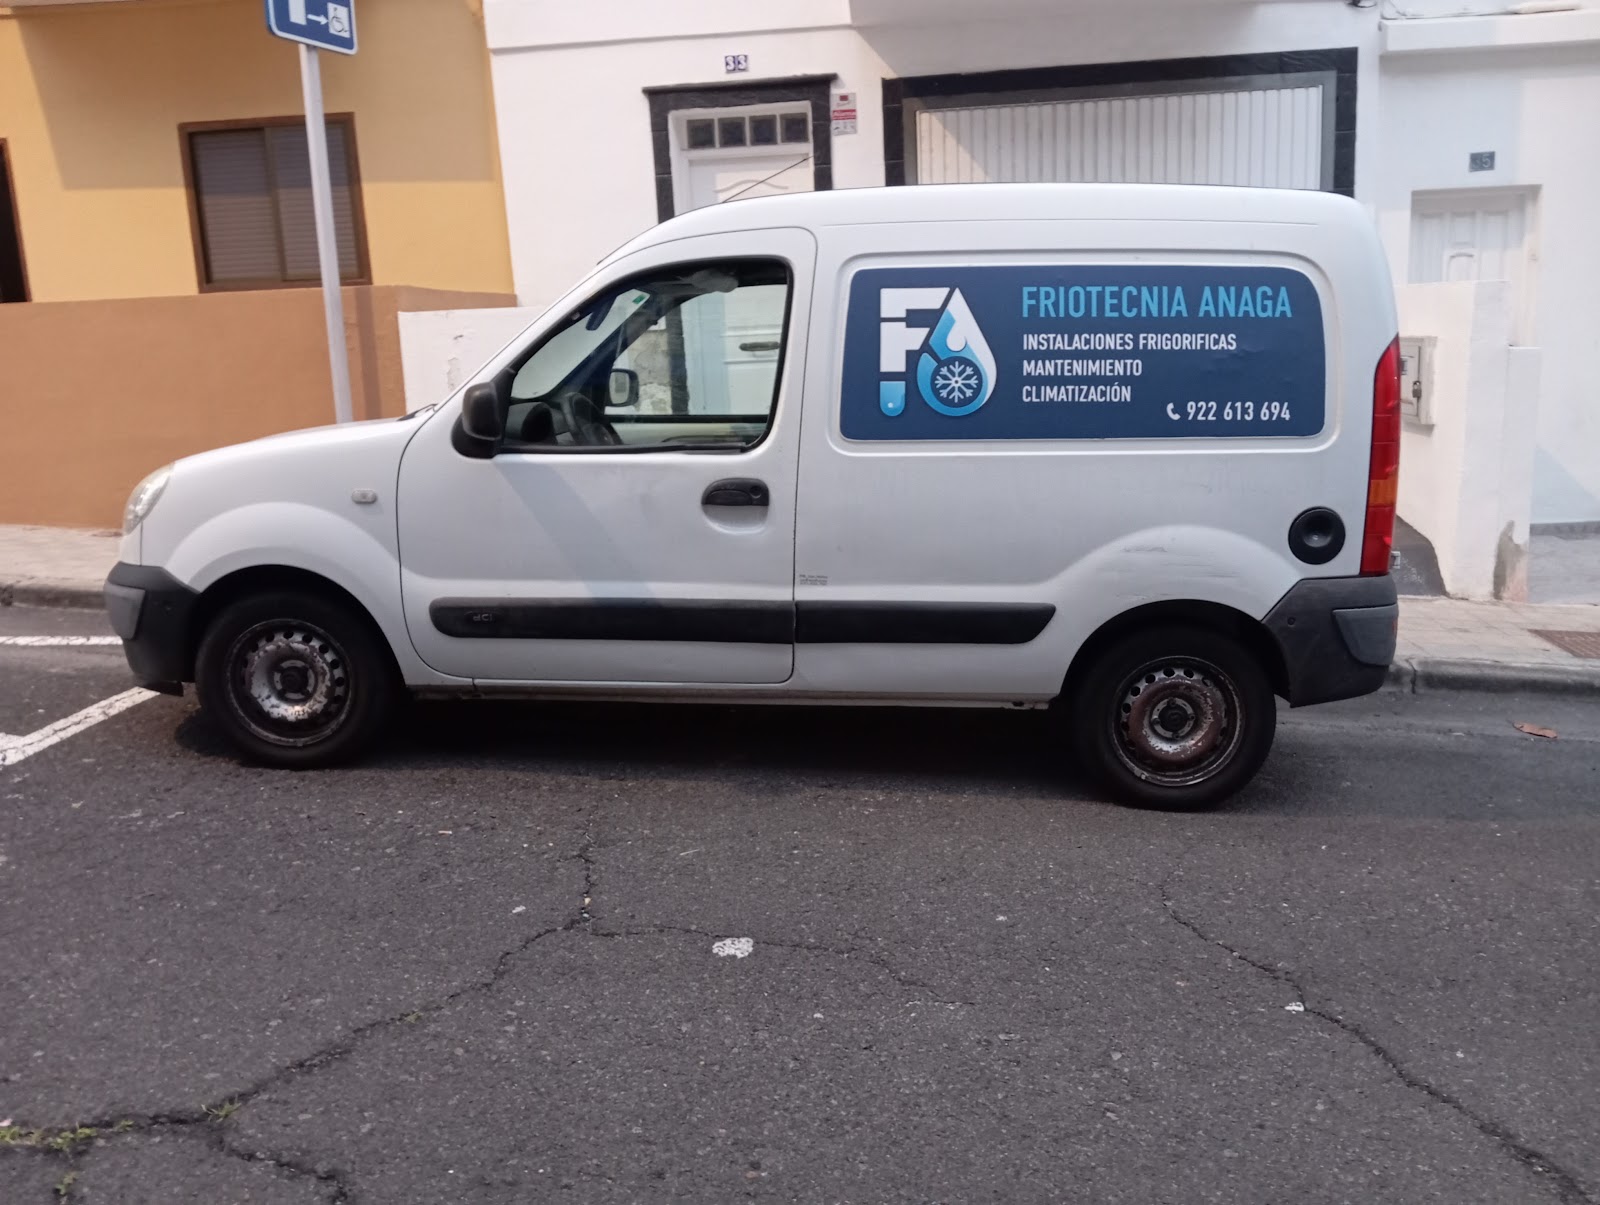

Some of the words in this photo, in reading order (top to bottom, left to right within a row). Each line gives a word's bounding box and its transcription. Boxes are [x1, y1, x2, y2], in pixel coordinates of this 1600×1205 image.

[726, 55, 747, 71] 33
[1022, 285, 1188, 318] FRIOTECNIA
[1198, 285, 1292, 318] ANAGA
[1023, 333, 1134, 351] INSTALACIONES
[1138, 333, 1237, 351] FRIGORIFICAS
[1022, 359, 1143, 377] MANTENIMIENTO
[1022, 381, 1132, 403] CLIMATIZACIÓN
[1186, 401, 1217, 421] 922
[1223, 401, 1254, 421] 613
[1260, 401, 1291, 421] 694
